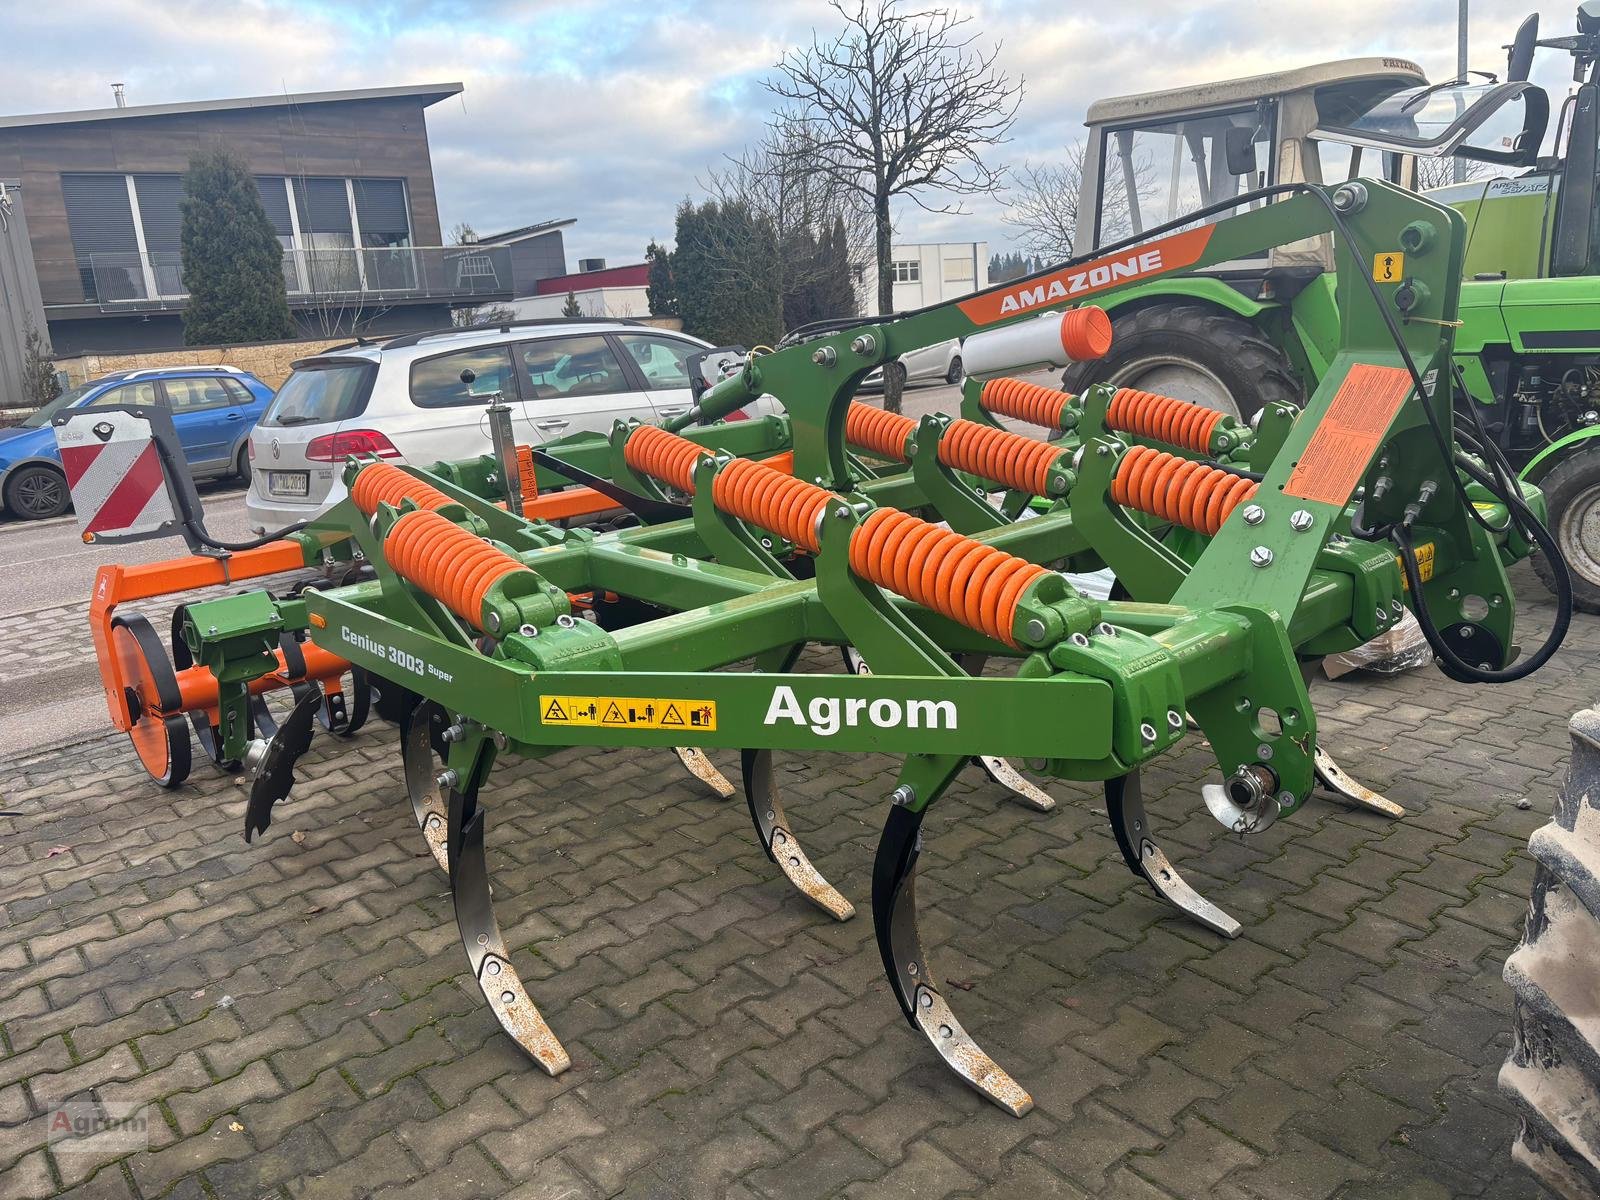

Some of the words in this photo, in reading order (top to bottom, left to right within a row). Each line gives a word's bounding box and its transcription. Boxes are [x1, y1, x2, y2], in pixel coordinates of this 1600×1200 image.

[1000, 249, 1163, 314] AMAZONE
[388, 646, 425, 677] 3003
[428, 663, 453, 684] Super
[763, 685, 958, 736] Agrom
